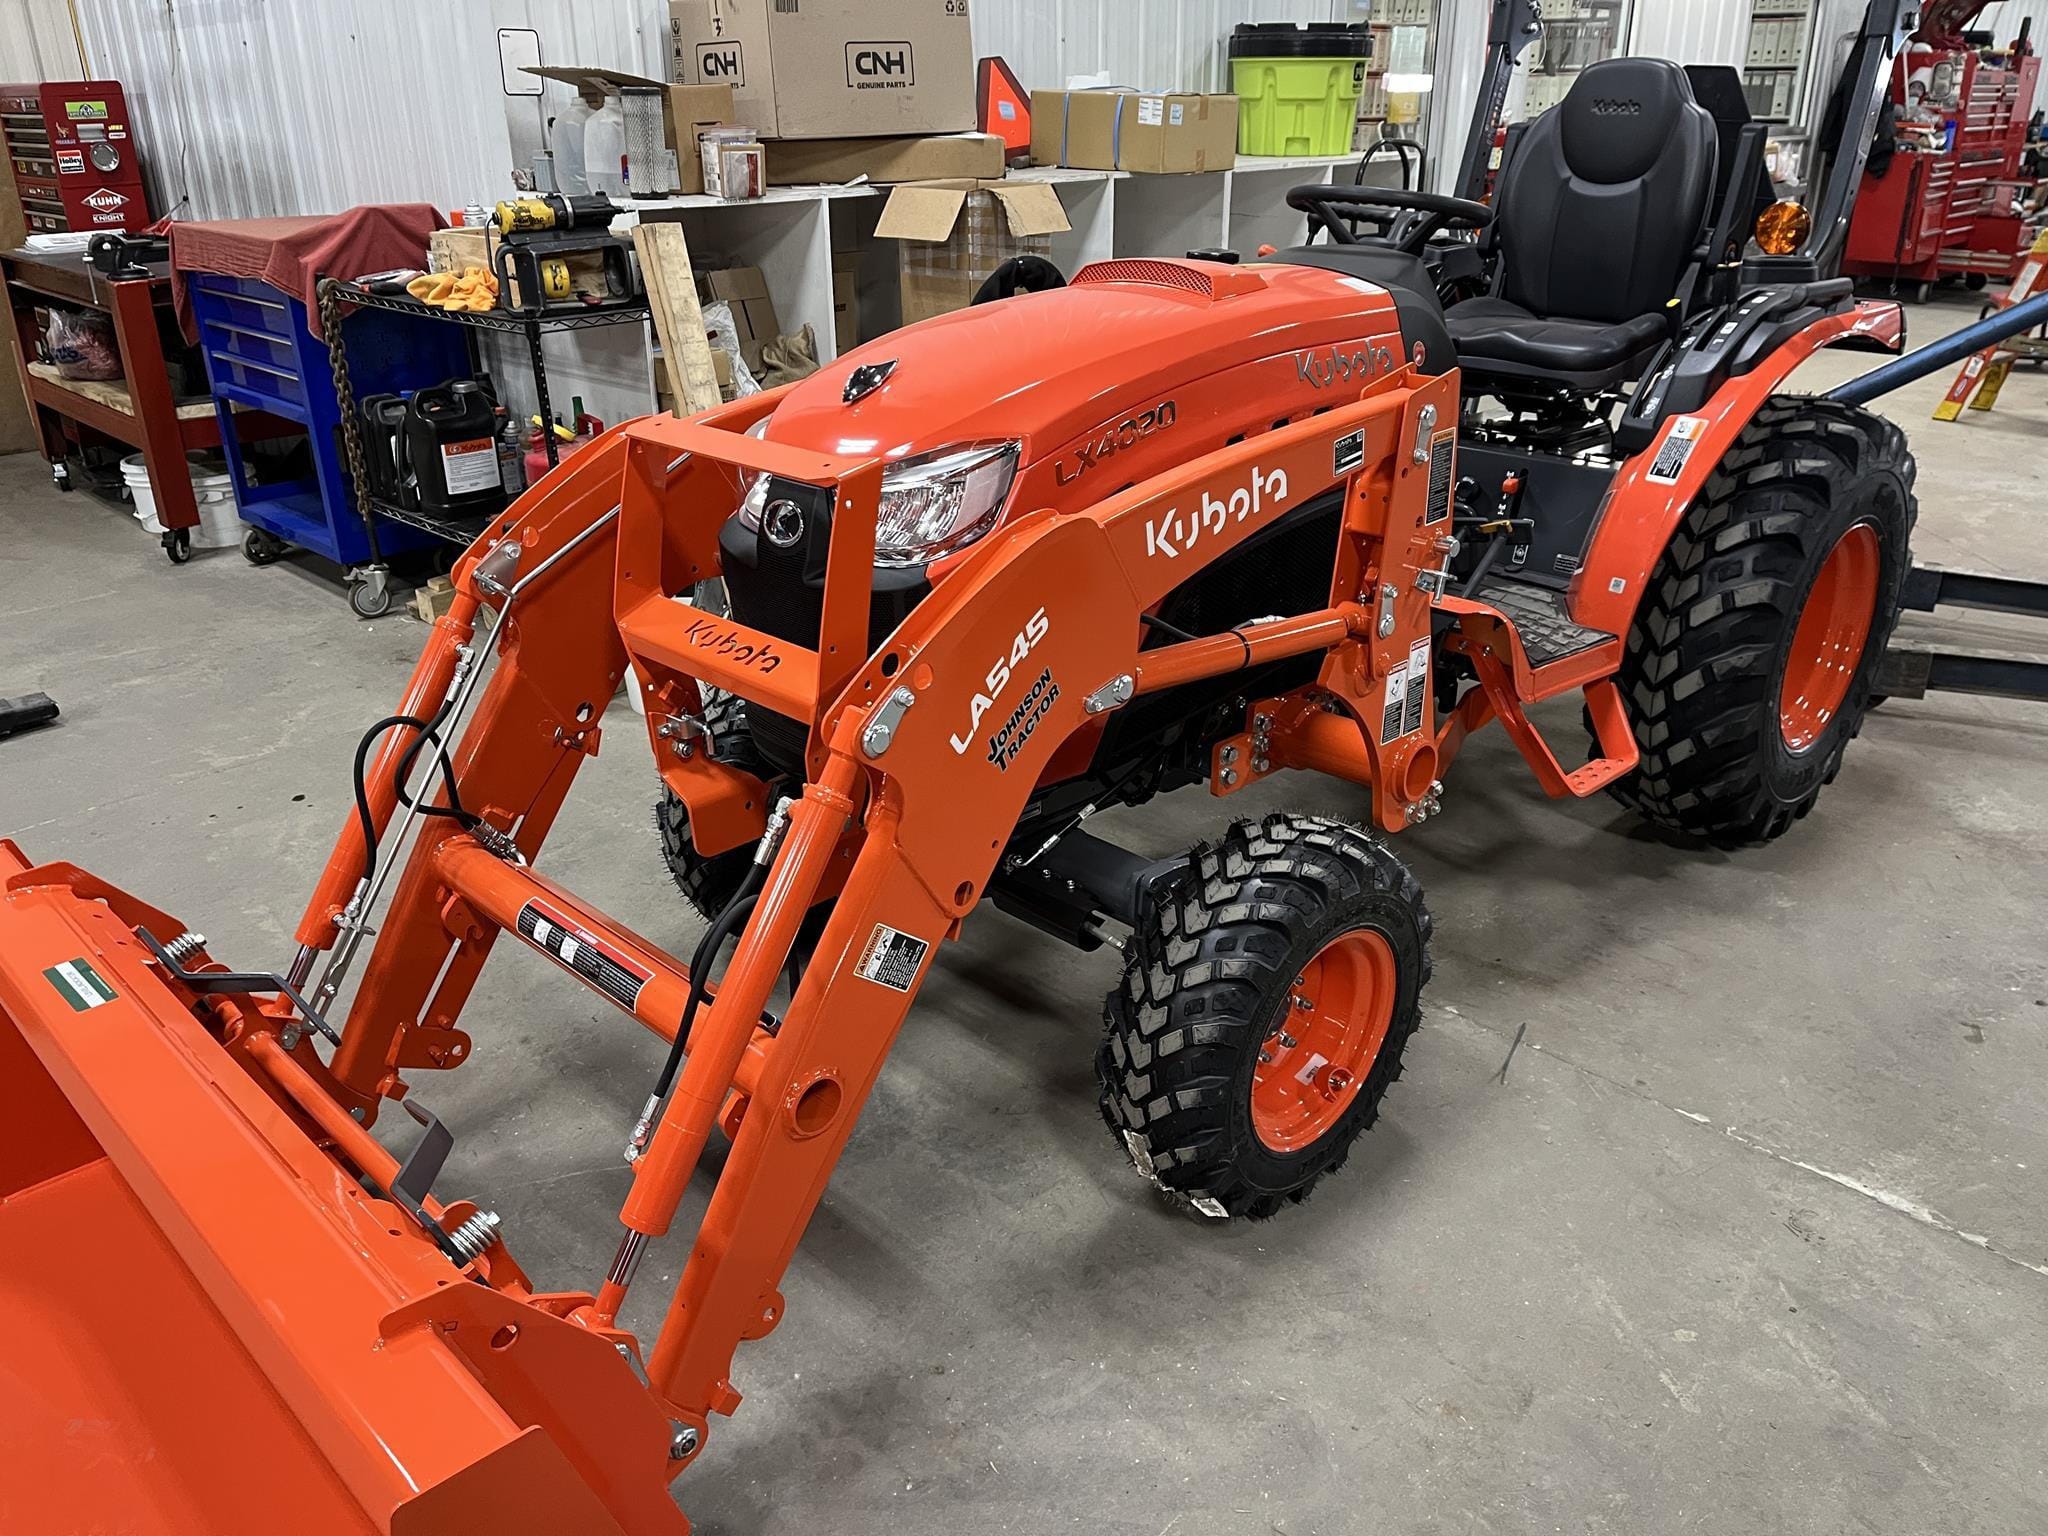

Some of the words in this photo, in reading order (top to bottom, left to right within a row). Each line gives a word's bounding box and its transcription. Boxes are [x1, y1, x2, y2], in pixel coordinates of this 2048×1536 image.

[703, 51, 738, 77] CNH
[855, 50, 905, 75] CNH
[856, 81, 885, 89] GENUINE
[89, 195, 122, 207] KUHN
[1295, 339, 1393, 388] Kubota
[1055, 400, 1176, 487] LX4020
[1145, 466, 1288, 558] Kubota
[684, 619, 781, 674] Kubota
[949, 606, 1049, 755] LA545
[986, 667, 1052, 762] JOHNSON
[994, 683, 1060, 772] TRACTOR
